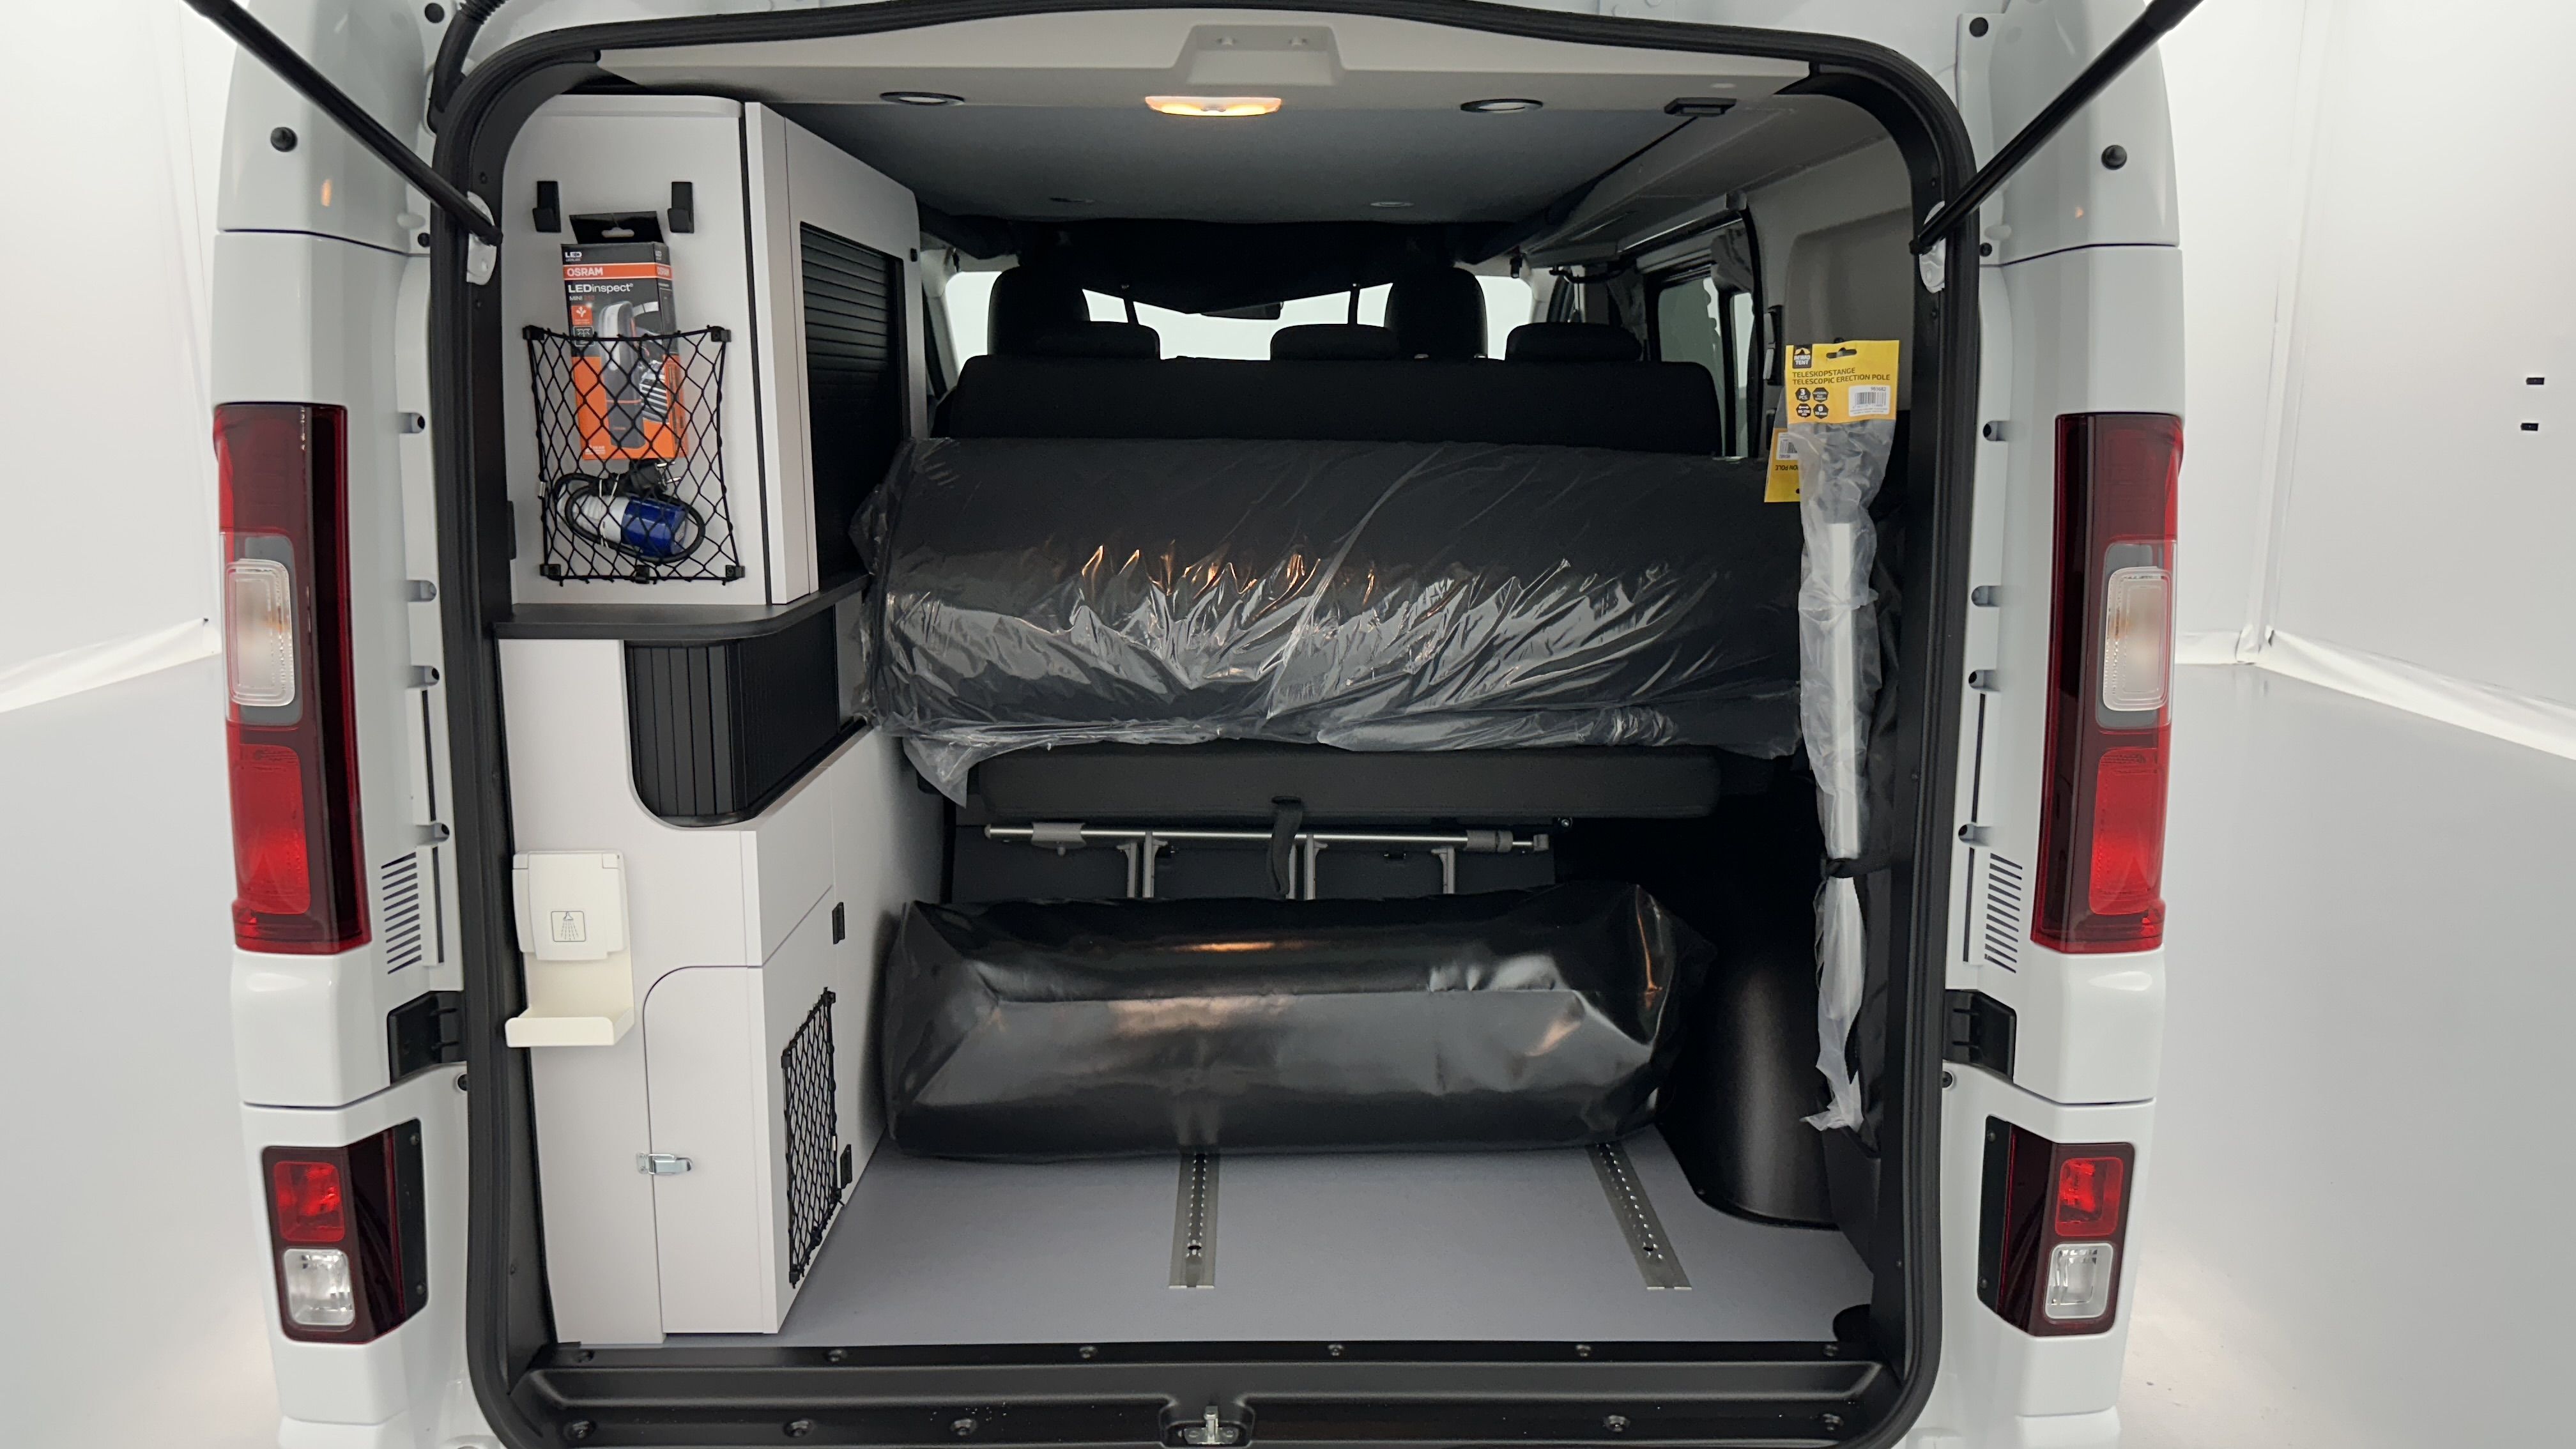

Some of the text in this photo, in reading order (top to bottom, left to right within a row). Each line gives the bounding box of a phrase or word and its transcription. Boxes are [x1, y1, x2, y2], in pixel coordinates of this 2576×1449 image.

[567, 267, 603, 276] OSRAM
[1792, 367, 1855, 378] TELESKOPSTANGE
[1836, 374, 1871, 383] ERECTION
